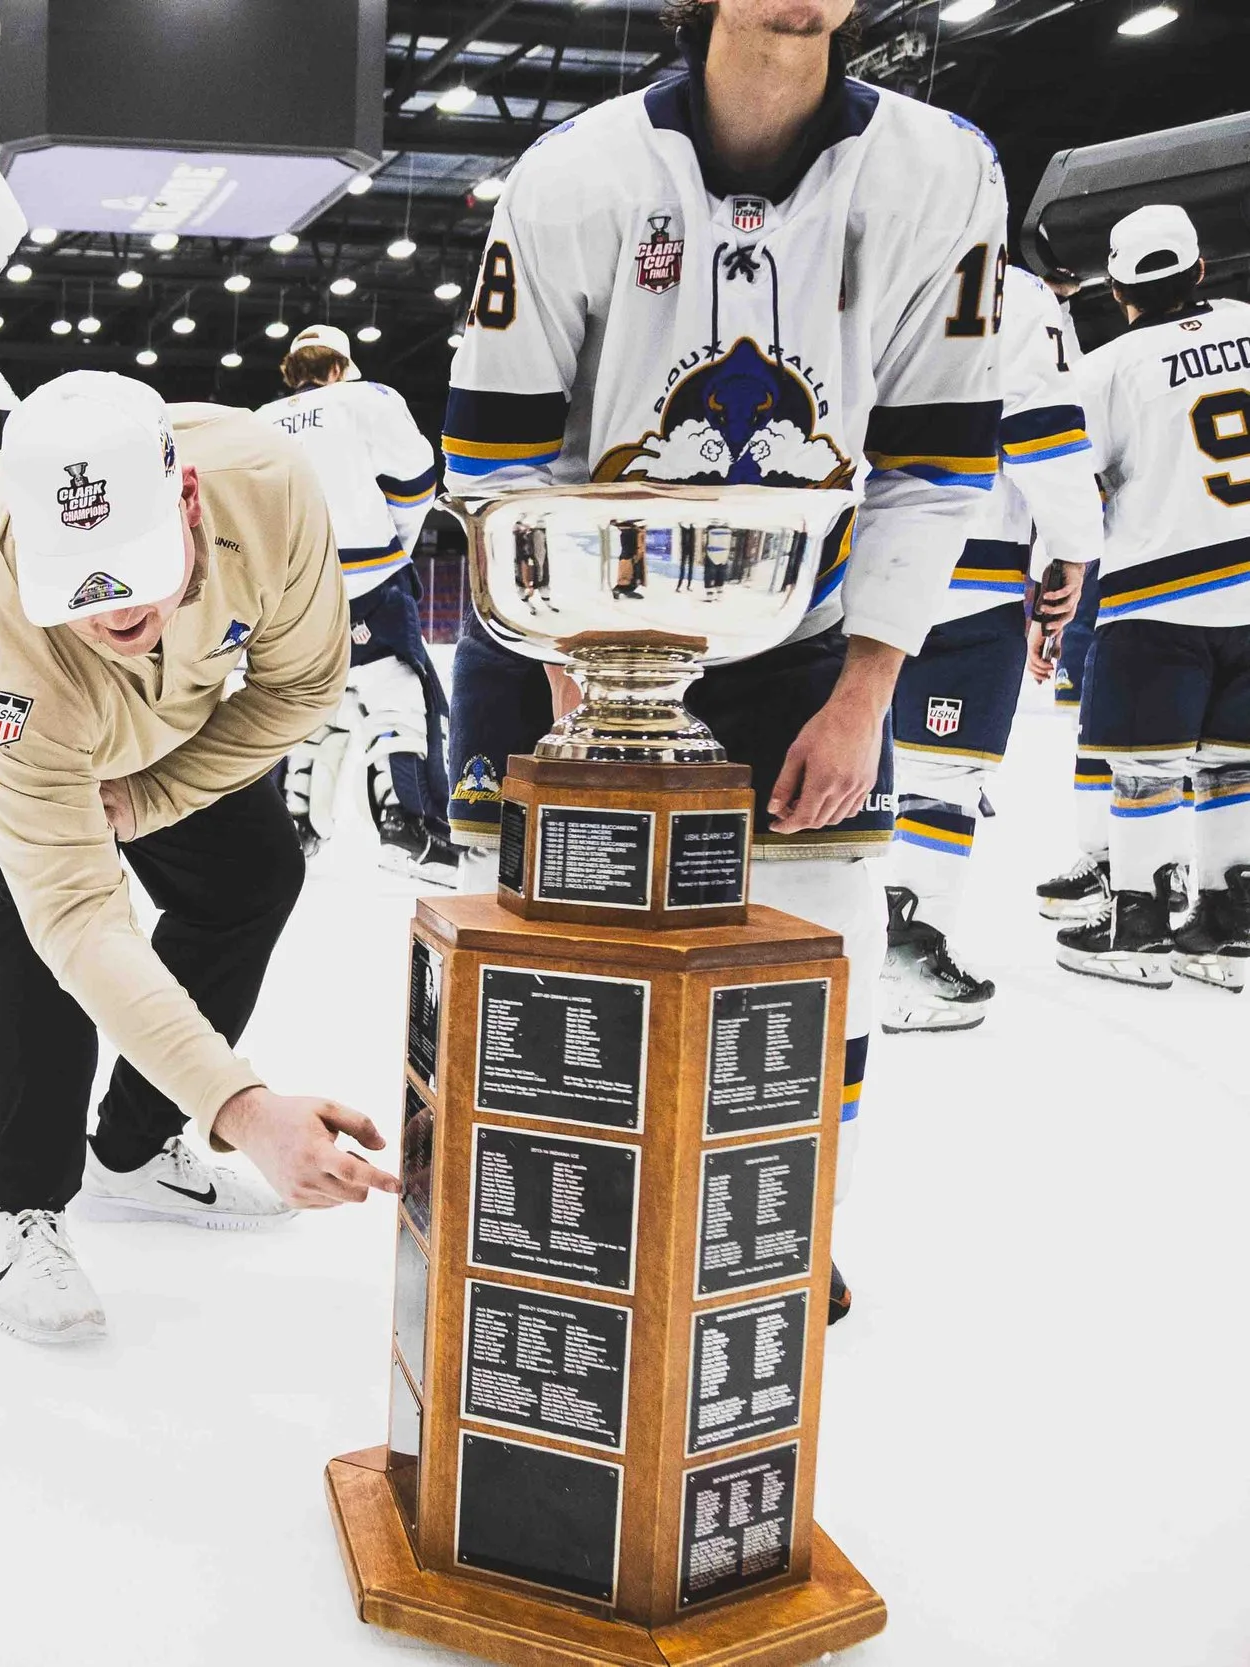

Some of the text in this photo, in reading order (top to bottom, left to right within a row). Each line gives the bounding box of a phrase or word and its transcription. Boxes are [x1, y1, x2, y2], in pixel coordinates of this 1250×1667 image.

[735, 208, 762, 217] USHL
[638, 242, 684, 257] CLARK
[644, 255, 675, 270] CUP
[649, 268, 669, 280] FINAL
[467, 240, 517, 330] 8
[654, 341, 829, 420] SIOUX FALLS
[58, 481, 106, 502] CLARK
[69, 496, 98, 511] CUP
[62, 503, 109, 523] CHAMPIONS
[214, 536, 241, 553] UNRL
[929, 709, 958, 719] USHL
